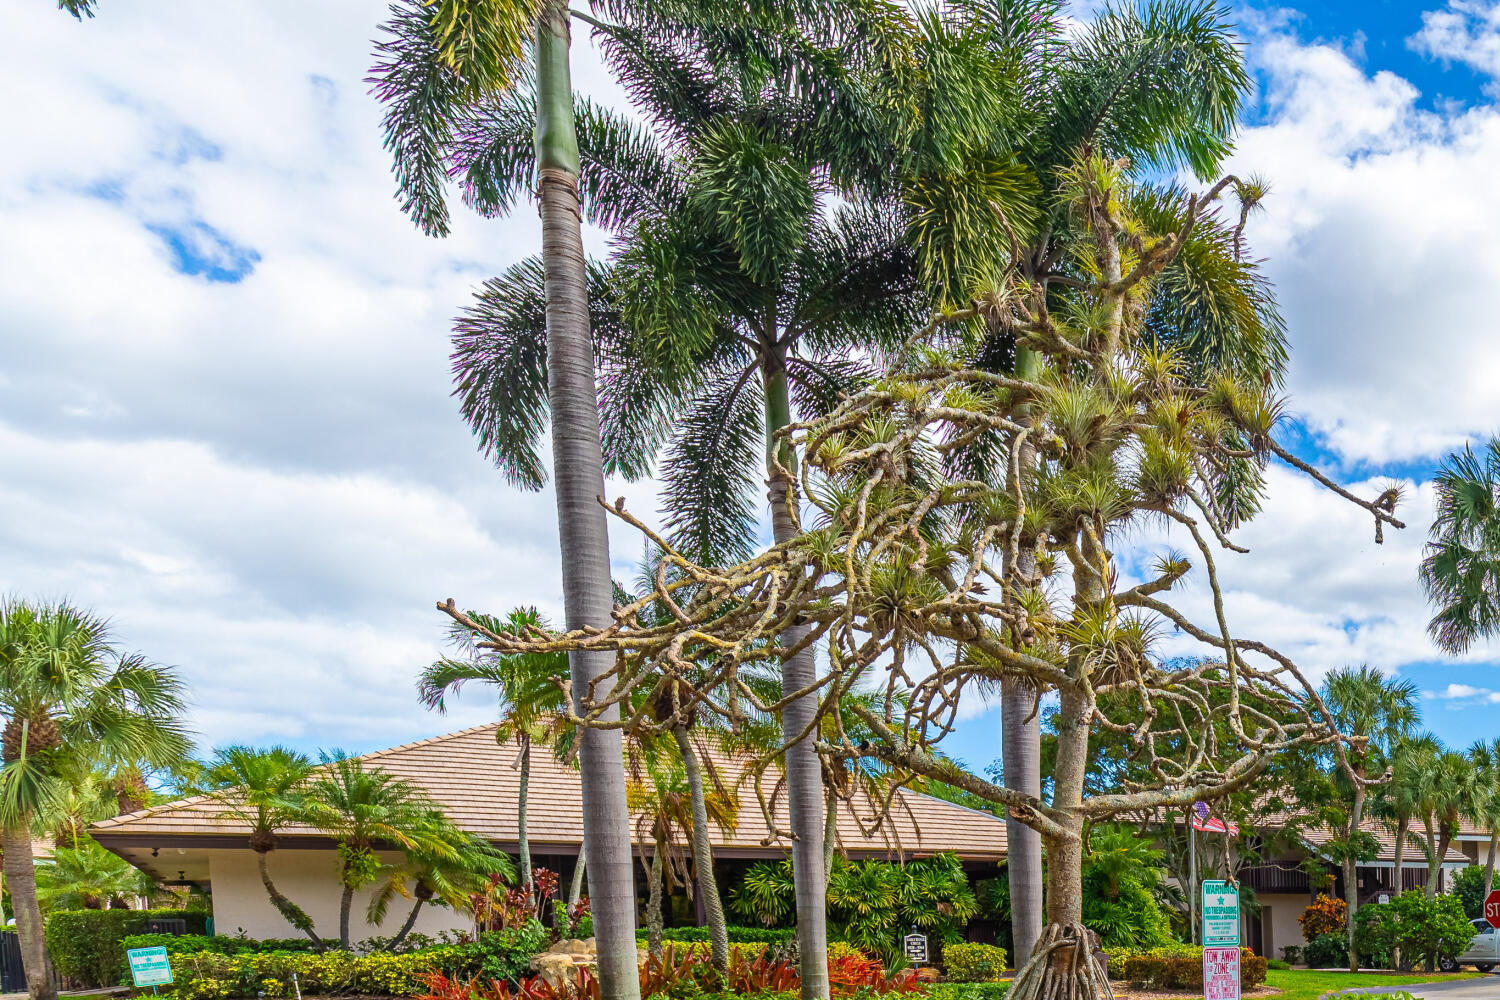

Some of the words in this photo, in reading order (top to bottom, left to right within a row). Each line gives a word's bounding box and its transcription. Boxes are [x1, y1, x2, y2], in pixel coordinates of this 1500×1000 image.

[1206, 951, 1218, 963] TOW
[1220, 951, 1237, 962] AWAY
[1214, 962, 1230, 975] ZONE
